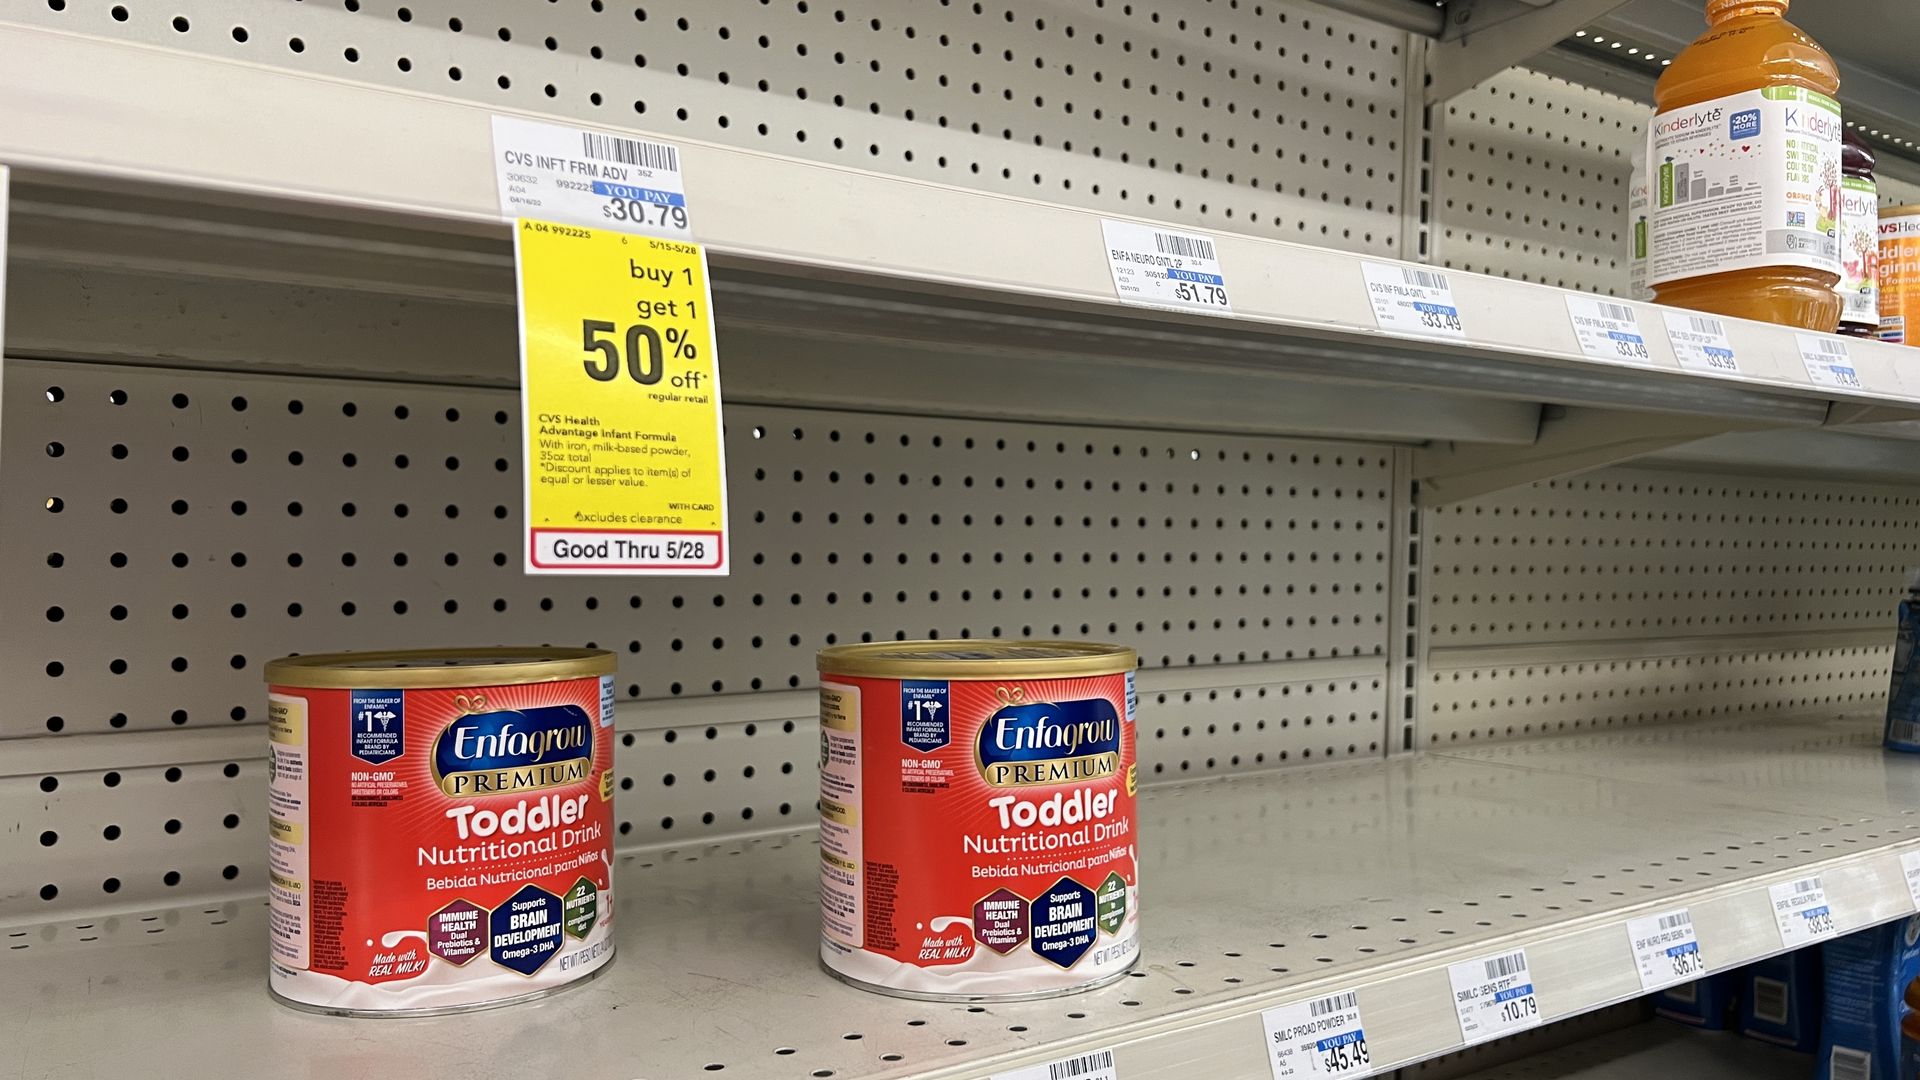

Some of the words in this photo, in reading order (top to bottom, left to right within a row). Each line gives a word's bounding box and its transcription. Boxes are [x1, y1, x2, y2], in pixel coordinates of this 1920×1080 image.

[1733, 122, 1757, 131] MORE
[1786, 140, 1795, 148] NO
[505, 150, 532, 166] CVS
[537, 156, 566, 172] INFT
[570, 161, 598, 178] FRM
[603, 166, 628, 181] ADV
[556, 179, 595, 193] 992225
[604, 183, 639, 200] YOU
[644, 192, 671, 204] PAY
[603, 198, 688, 230] $30.79
[524, 222, 533, 231] A
[535, 223, 548, 233] 04
[552, 226, 591, 239] 992225
[622, 237, 628, 245] 6
[650, 240, 697, 255] 5/15-5/28
[1112, 250, 1131, 262] ENFA
[1131, 253, 1155, 266] NEURO
[1156, 256, 1174, 268] GNTL
[630, 258, 673, 288] buy
[682, 268, 692, 286] 1
[1174, 270, 1196, 281] YOU
[1199, 274, 1215, 283] PAY
[1175, 282, 1227, 306] $51.79
[1370, 282, 1383, 292] CVS
[637, 300, 678, 319] get
[686, 301, 696, 319] 1
[1420, 303, 1436, 313] YOU
[1438, 306, 1451, 314] PAY
[1421, 312, 1462, 330] $33.49
[583, 319, 697, 385] 50%
[648, 392, 682, 402] regular
[685, 394, 709, 404] retail
[539, 414, 562, 424] CVS
[565, 415, 600, 426] Health
[540, 426, 598, 438] Advantage
[602, 429, 632, 439] Infant
[635, 431, 677, 442] Formula
[540, 439, 563, 449] With
[567, 441, 590, 452] iron,
[593, 442, 647, 454] milk-based
[651, 445, 691, 457] powder,
[540, 453, 565, 462] 35oz
[569, 453, 591, 462] total
[595, 465, 631, 476] applies
[634, 466, 644, 476] to
[647, 467, 679, 478] item(s)
[682, 468, 691, 477] of
[540, 475, 570, 486] equal
[587, 476, 615, 485] lesser
[619, 478, 648, 487] value.
[669, 503, 690, 511] WITH
[630, 513, 683, 524] clearance
[554, 539, 608, 558] Good
[615, 541, 659, 559] Thru
[667, 542, 704, 559] 5/28
[358, 711, 372, 732] #1
[454, 723, 586, 762] Enfagrow
[995, 716, 1114, 754] Enfagrow
[454, 762, 583, 794] PREMIUM
[996, 756, 1112, 784] PREMIUM
[446, 794, 589, 840] Toddler
[989, 788, 1118, 830] Toddler
[418, 837, 558, 866] Nutritional
[562, 821, 602, 848] Drink
[963, 826, 1090, 854] Nutritional
[1094, 816, 1129, 842] Drink
[427, 874, 477, 890] Bebida
[480, 866, 553, 886] Nutricional
[555, 860, 578, 872] para
[578, 850, 598, 865] Niños
[577, 886, 585, 896] 22
[1050, 891, 1081, 903] Supports
[512, 898, 546, 911] Supports
[566, 892, 595, 910] NUTRIENTS
[983, 900, 1020, 910] IMMUNE
[439, 911, 479, 922] IMMUNE
[510, 909, 548, 930] BRAIN
[568, 911, 594, 926] complement
[985, 910, 1018, 920] HEALTH
[1049, 902, 1082, 922] BRAIN
[441, 921, 476, 932] HEALTH
[578, 923, 587, 931] diet
[982, 928, 1015, 937] Prebiotics
[994, 920, 1010, 928] Dual
[1035, 917, 1094, 938] DEVELOPMENT
[437, 939, 474, 949] Prebiotics
[450, 931, 467, 940] Dual
[494, 923, 561, 948] DEVELOPMENT
[987, 936, 1017, 944] Vitamins
[1042, 938, 1074, 951] Omega-3
[1075, 935, 1089, 944] DHA
[373, 953, 397, 965] Made
[398, 950, 416, 961] with
[443, 947, 475, 956] Vitamins
[502, 945, 538, 960] Omega-3
[540, 941, 555, 951] DHA
[368, 966, 393, 977] REAL
[395, 960, 426, 974] MILK!
[1457, 988, 1478, 1002] SIMLC
[1498, 979, 1511, 991] RTF
[1500, 991, 1515, 1000] YOU
[1516, 987, 1528, 996] PAY
[1501, 997, 1536, 1022] $10.79
[1274, 1029, 1292, 1043] SMLC
[1293, 1022, 1316, 1038] PROAD
[1317, 1015, 1345, 1032] POWDER
[1322, 1037, 1340, 1050] YOU
[1342, 1032, 1357, 1044] PAY
[1325, 1039, 1370, 1072] $45.49
